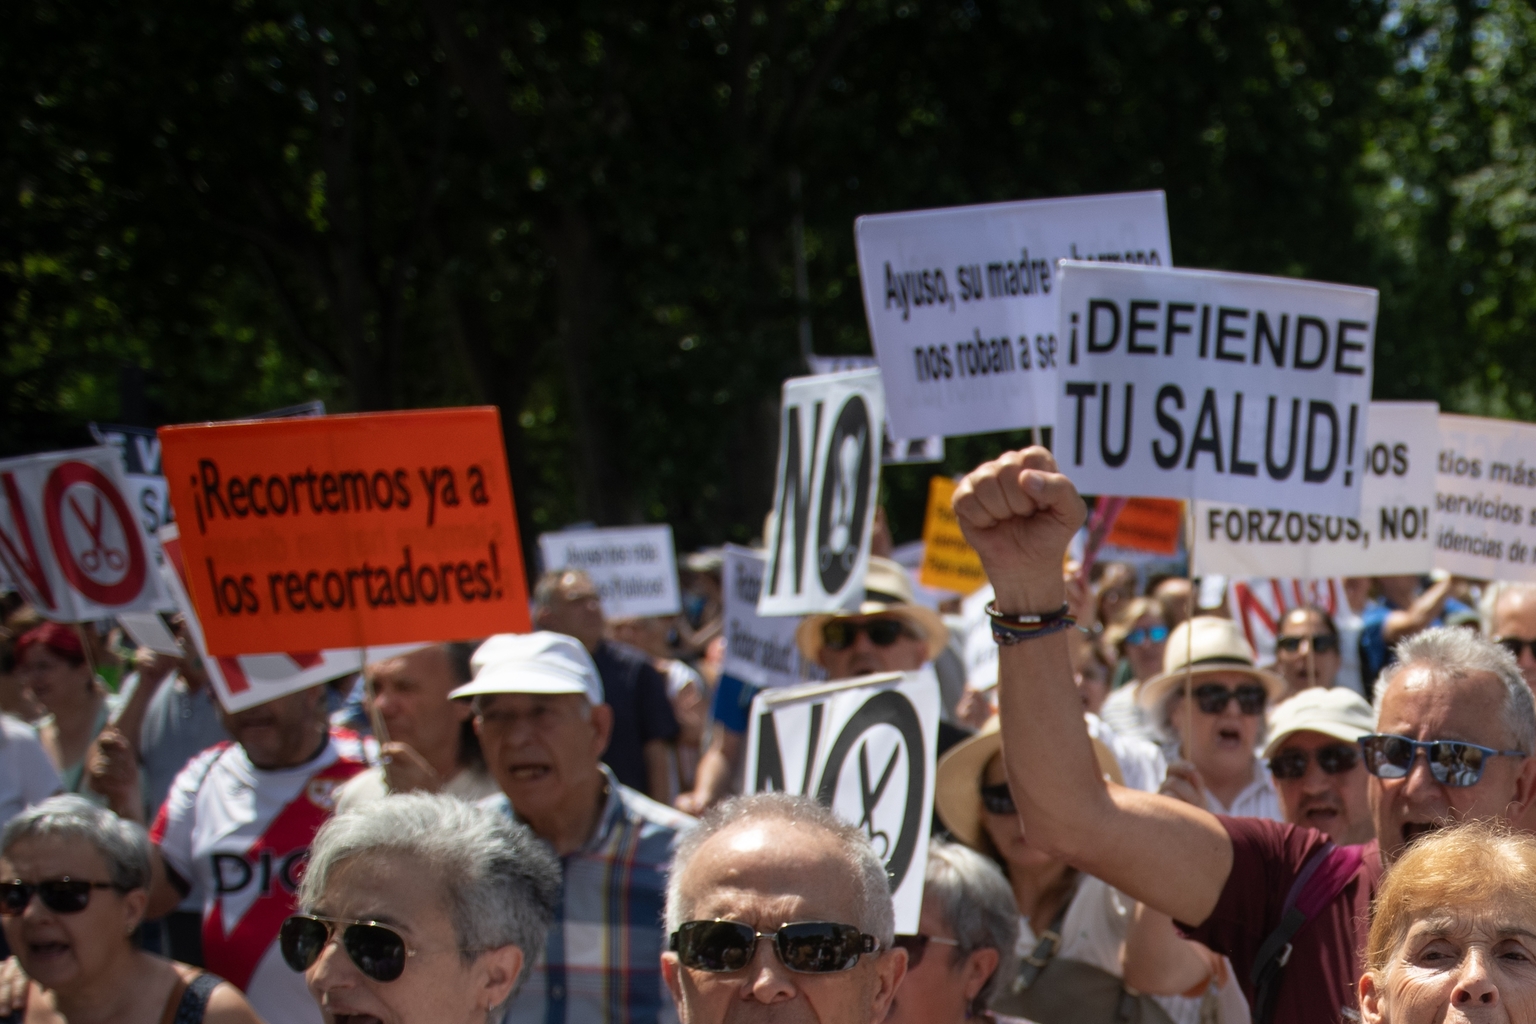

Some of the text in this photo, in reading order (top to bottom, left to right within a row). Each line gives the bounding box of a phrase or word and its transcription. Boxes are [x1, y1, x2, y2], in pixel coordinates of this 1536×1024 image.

[885, 260, 956, 321] Ayuso,
[957, 263, 984, 301] su
[987, 247, 1051, 298] madre
[915, 343, 953, 382] nos
[956, 327, 1015, 377] roban
[1019, 333, 1031, 370] a
[1068, 298, 1369, 376] ¡DEFIENDE
[1066, 381, 1359, 487] TU SALUD!
[1365, 442, 1409, 476] OS
[190, 457, 411, 535] ¡Recortemos
[419, 464, 460, 527] ya
[466, 462, 490, 506] a
[769, 394, 872, 596] NO
[1207, 508, 1370, 549] FORZOSOS,
[1380, 506, 1429, 541] NO!
[205, 539, 504, 616] los recortadores!
[1509, 538, 1527, 563] de
